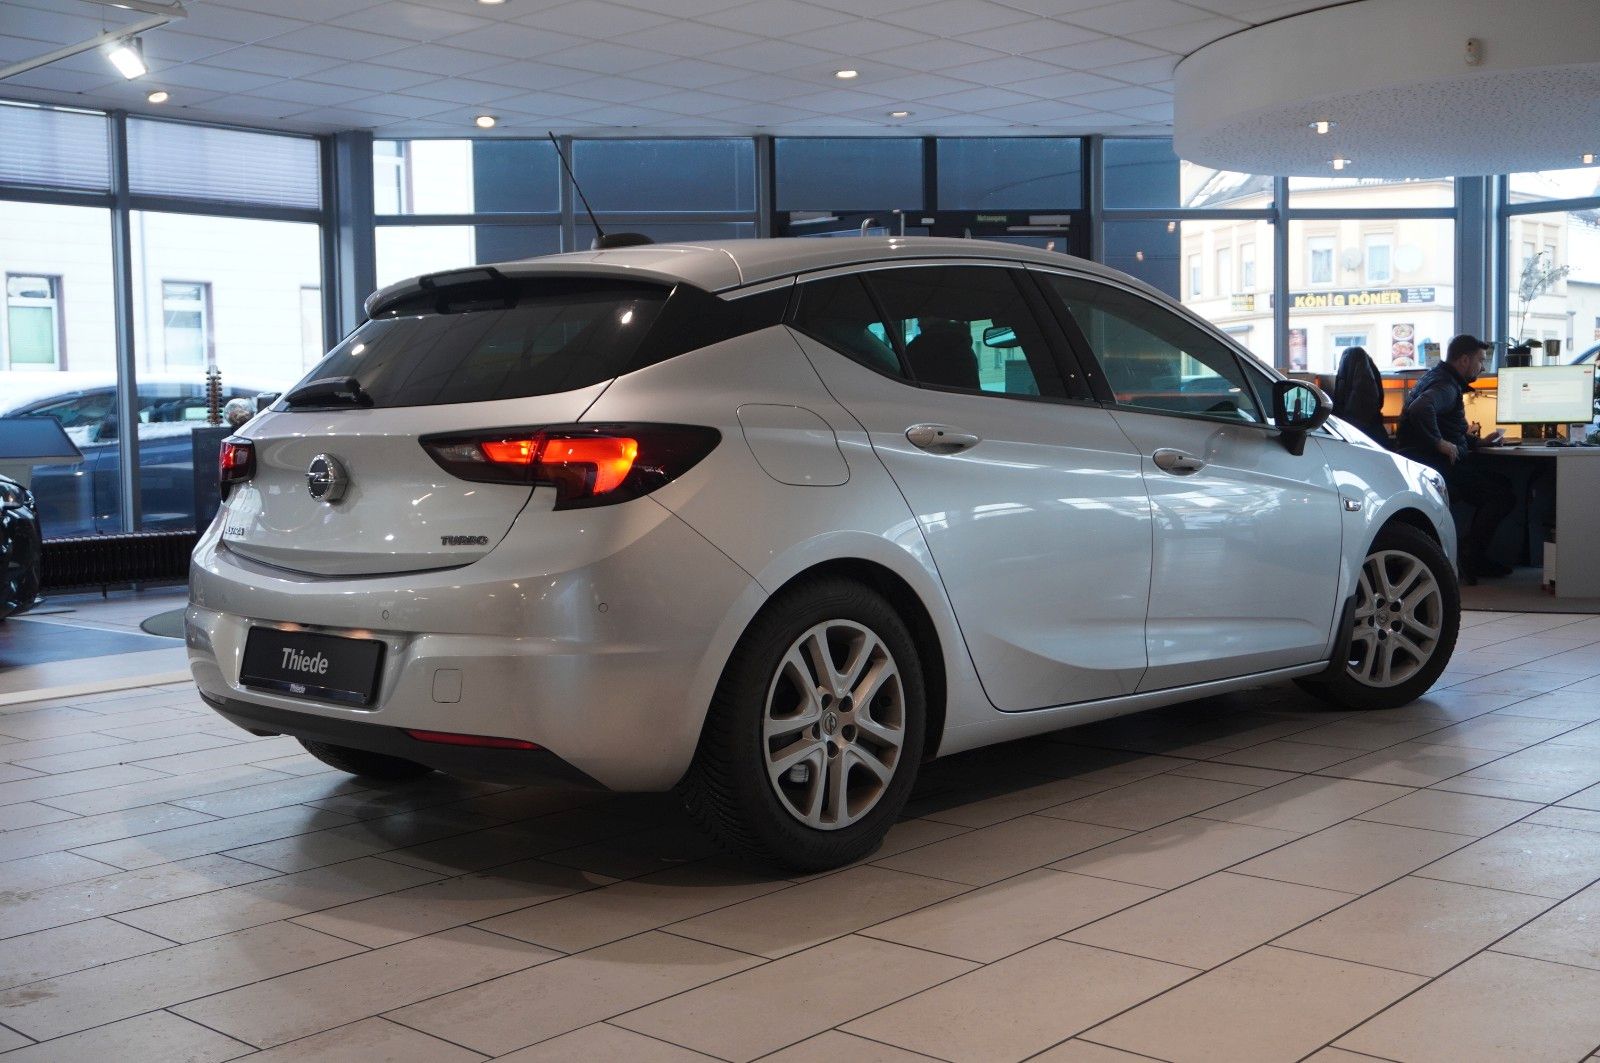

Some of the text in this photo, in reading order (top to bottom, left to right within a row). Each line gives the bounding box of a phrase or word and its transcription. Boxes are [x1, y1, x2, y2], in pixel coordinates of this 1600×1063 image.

[1349, 290, 1403, 305] DÖNER
[440, 535, 489, 546] TURBO
[281, 647, 329, 675] Thiede
[289, 683, 306, 694] Thiede
